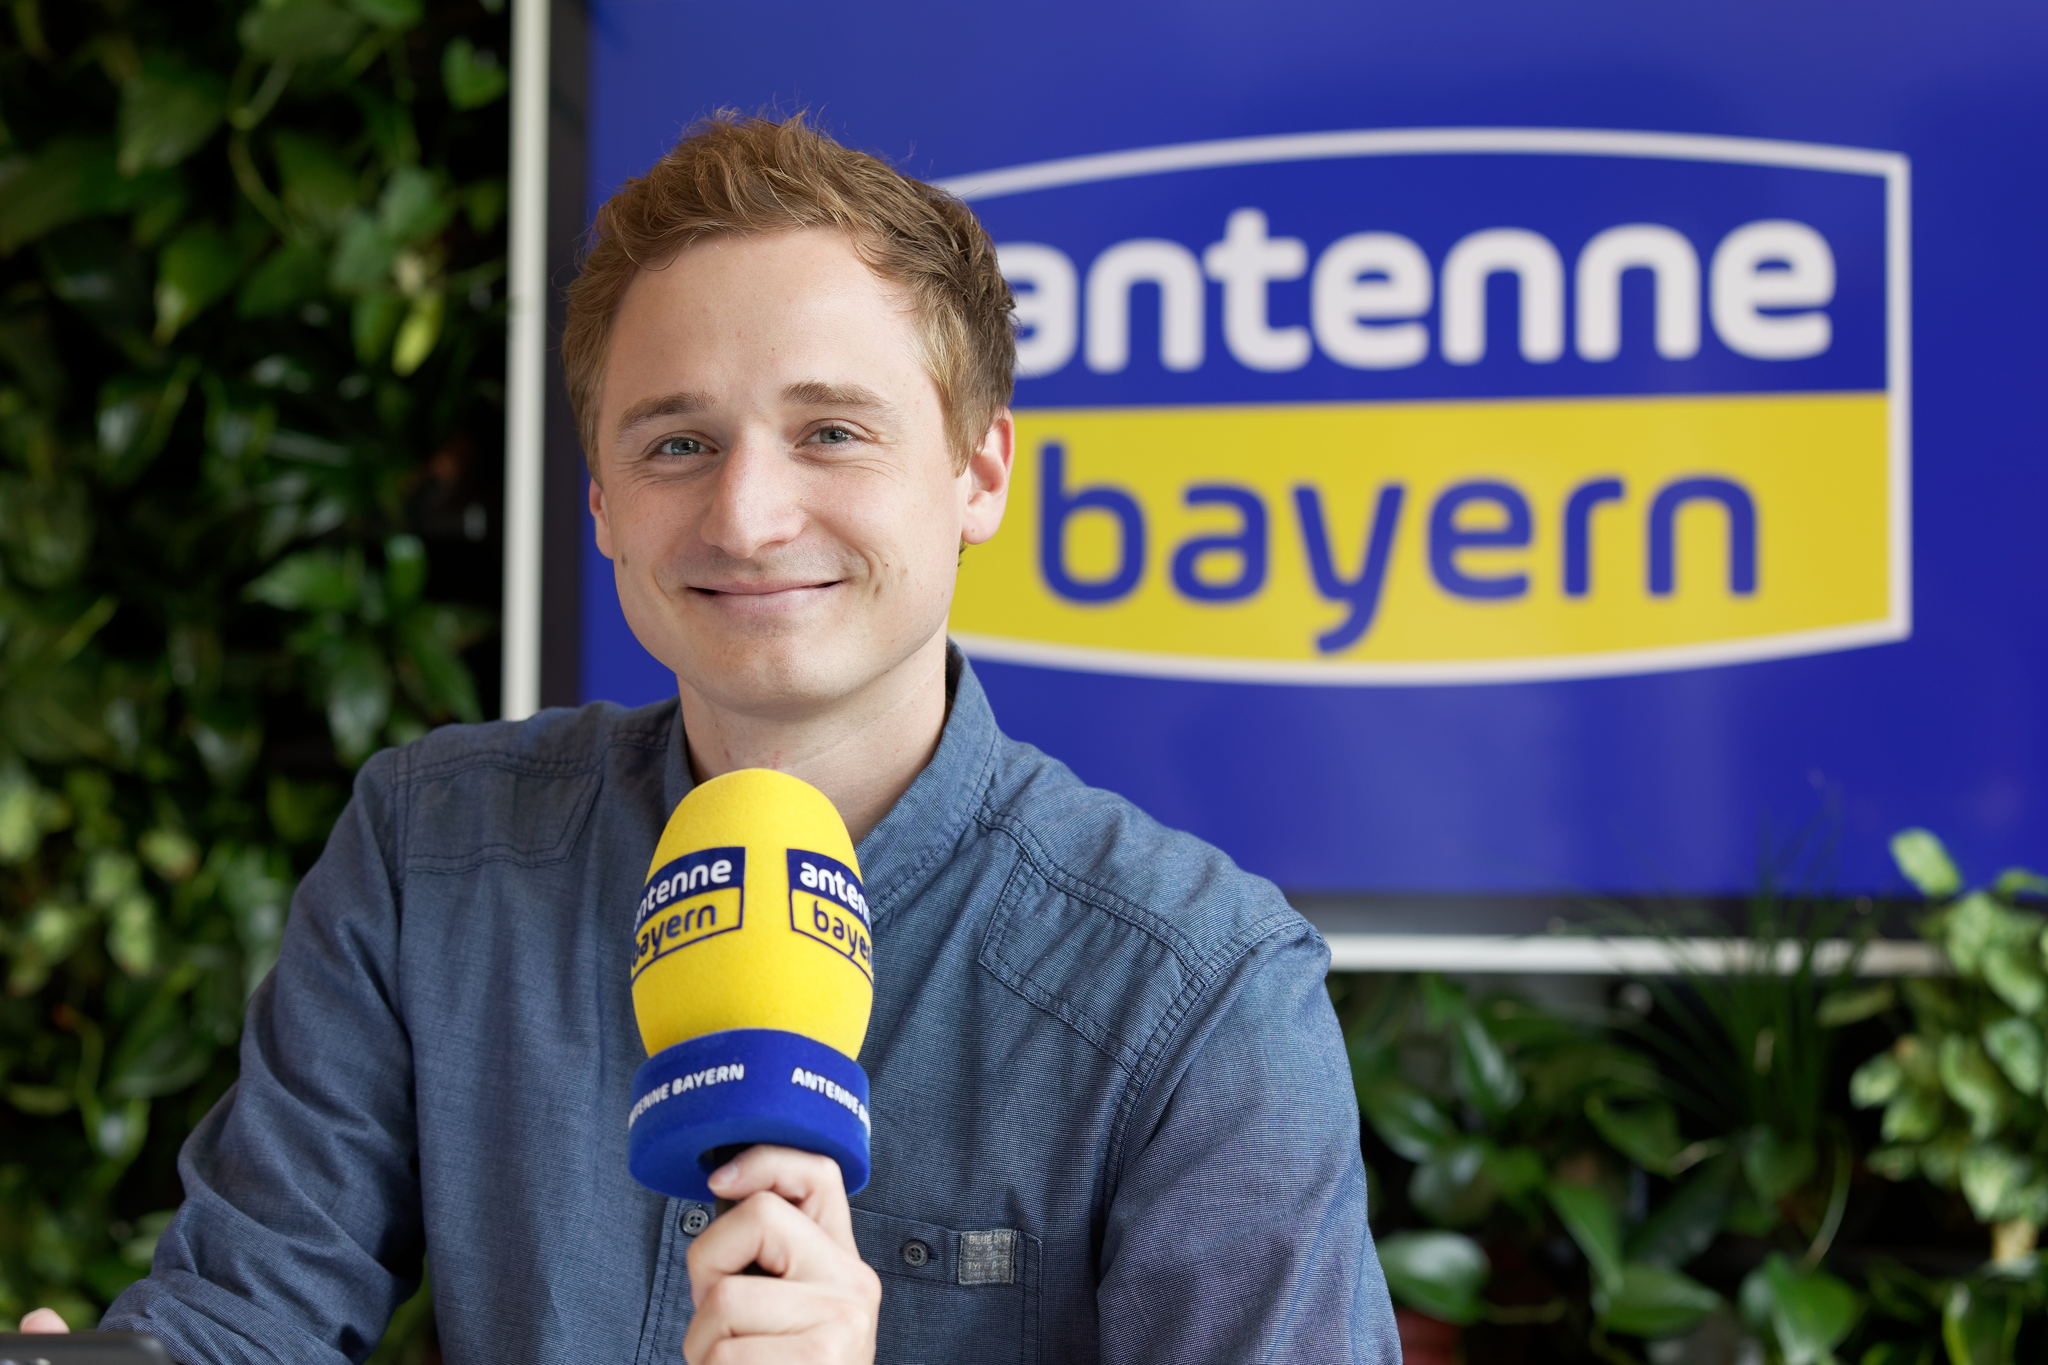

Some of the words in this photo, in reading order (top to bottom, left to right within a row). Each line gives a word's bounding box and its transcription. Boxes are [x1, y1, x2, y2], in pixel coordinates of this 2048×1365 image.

[996, 206, 1837, 378] antenne
[1036, 440, 1760, 655] bayern
[634, 859, 732, 934] ntenne
[671, 1063, 745, 1096] BAYERN
[791, 1066, 860, 1115] ANTENNE
